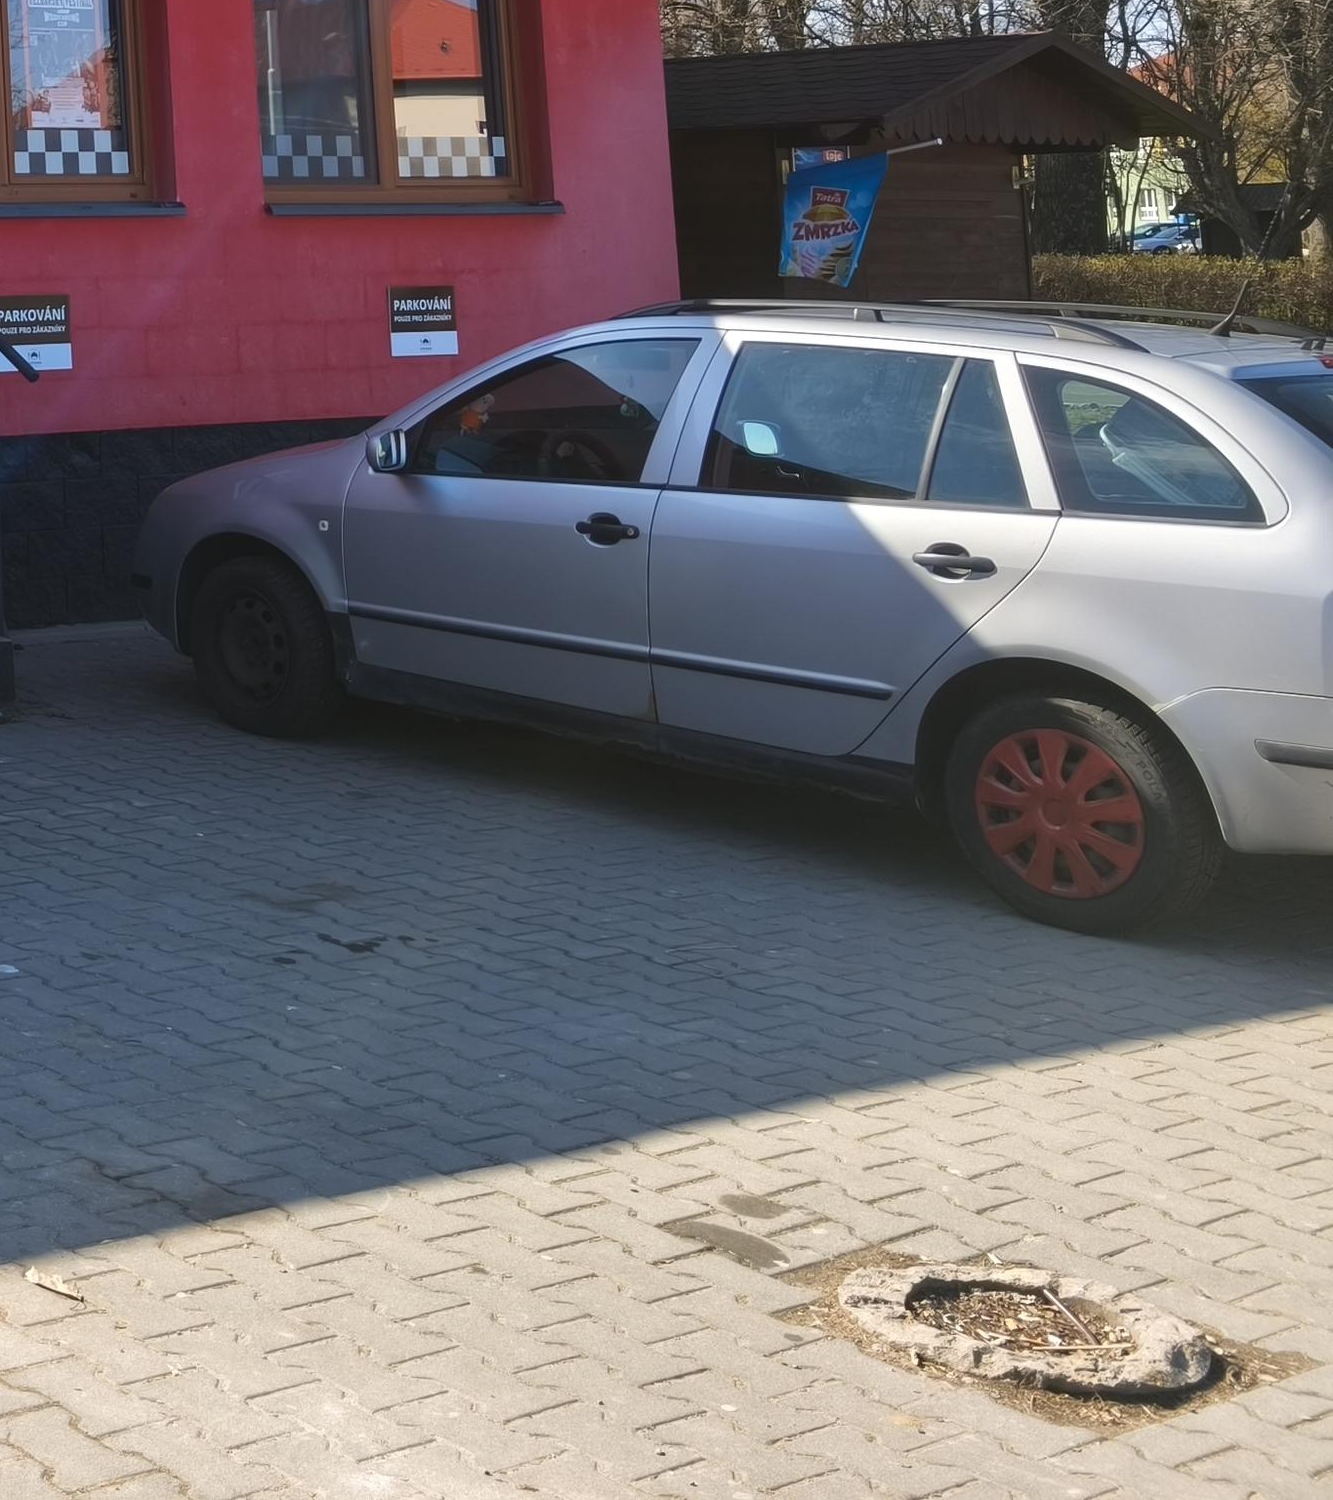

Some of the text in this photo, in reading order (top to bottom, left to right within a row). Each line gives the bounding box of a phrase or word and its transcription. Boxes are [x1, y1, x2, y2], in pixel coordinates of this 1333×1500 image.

[393, 295, 451, 311] PARKOVÁNÍ
[412, 314, 423, 322] PRO
[18, 326, 32, 334] PRO
[32, 323, 66, 334] ZÁKAZNÍKY
